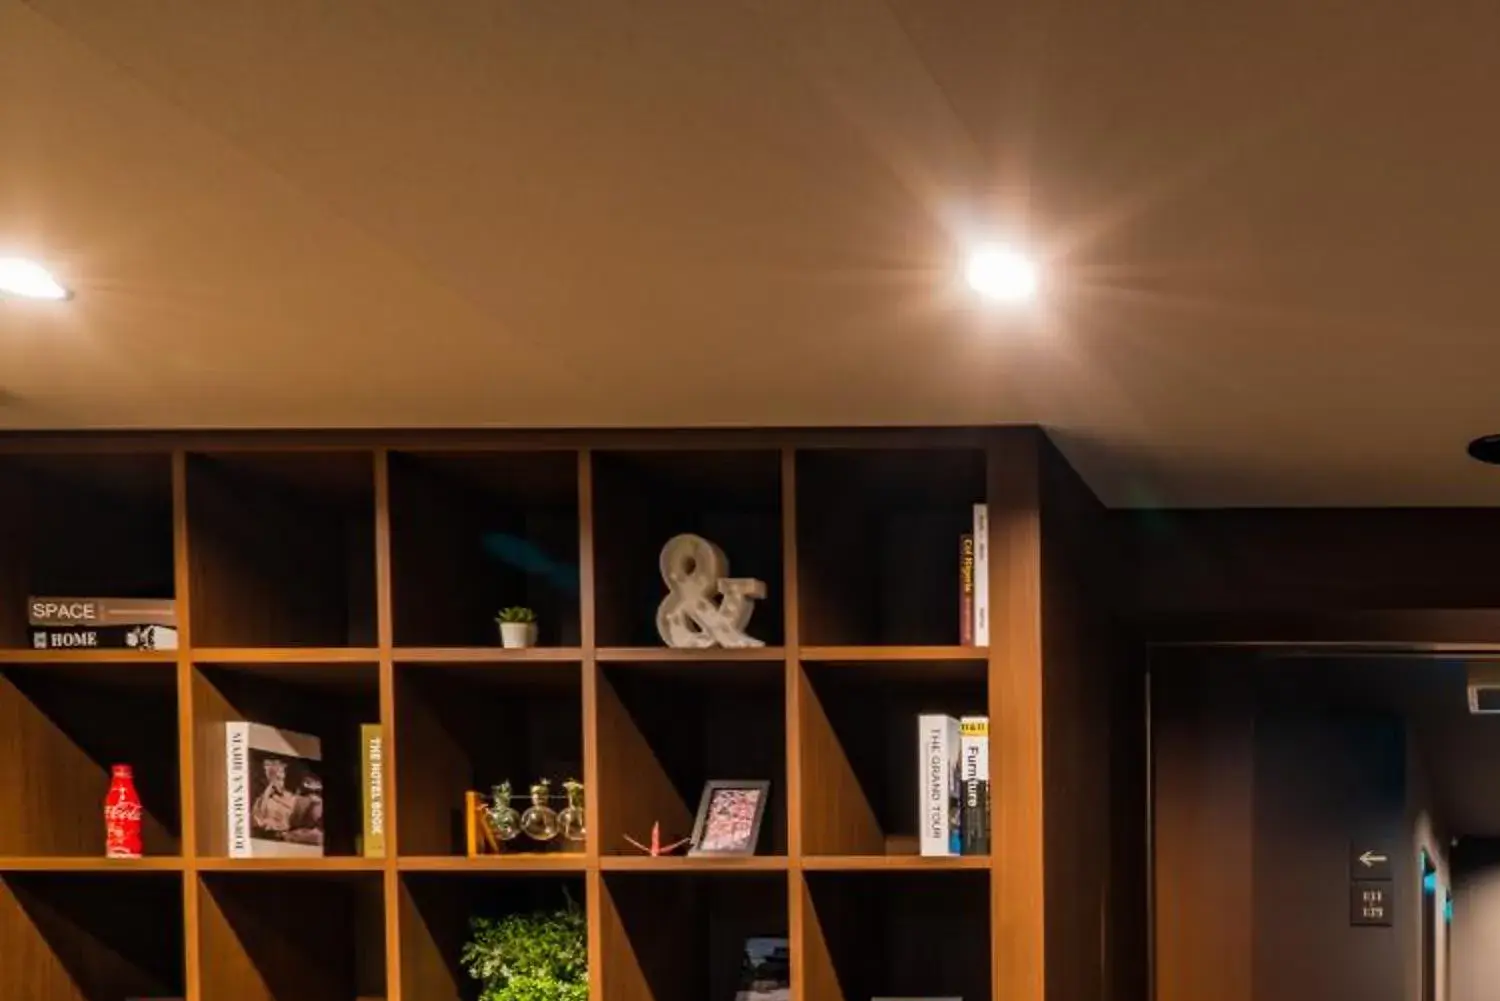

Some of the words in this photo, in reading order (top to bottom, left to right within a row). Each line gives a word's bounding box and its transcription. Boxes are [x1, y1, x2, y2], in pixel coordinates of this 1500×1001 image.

[32, 603, 96, 619] SPACE
[51, 632, 98, 647] HOME
[369, 737, 382, 761] THE
[930, 729, 942, 750] THE
[370, 763, 383, 804] HOTEL
[930, 756, 942, 801] GRAND
[967, 745, 980, 808] Furniture
[371, 807, 384, 835] BOOK
[931, 806, 943, 839] TOUR
